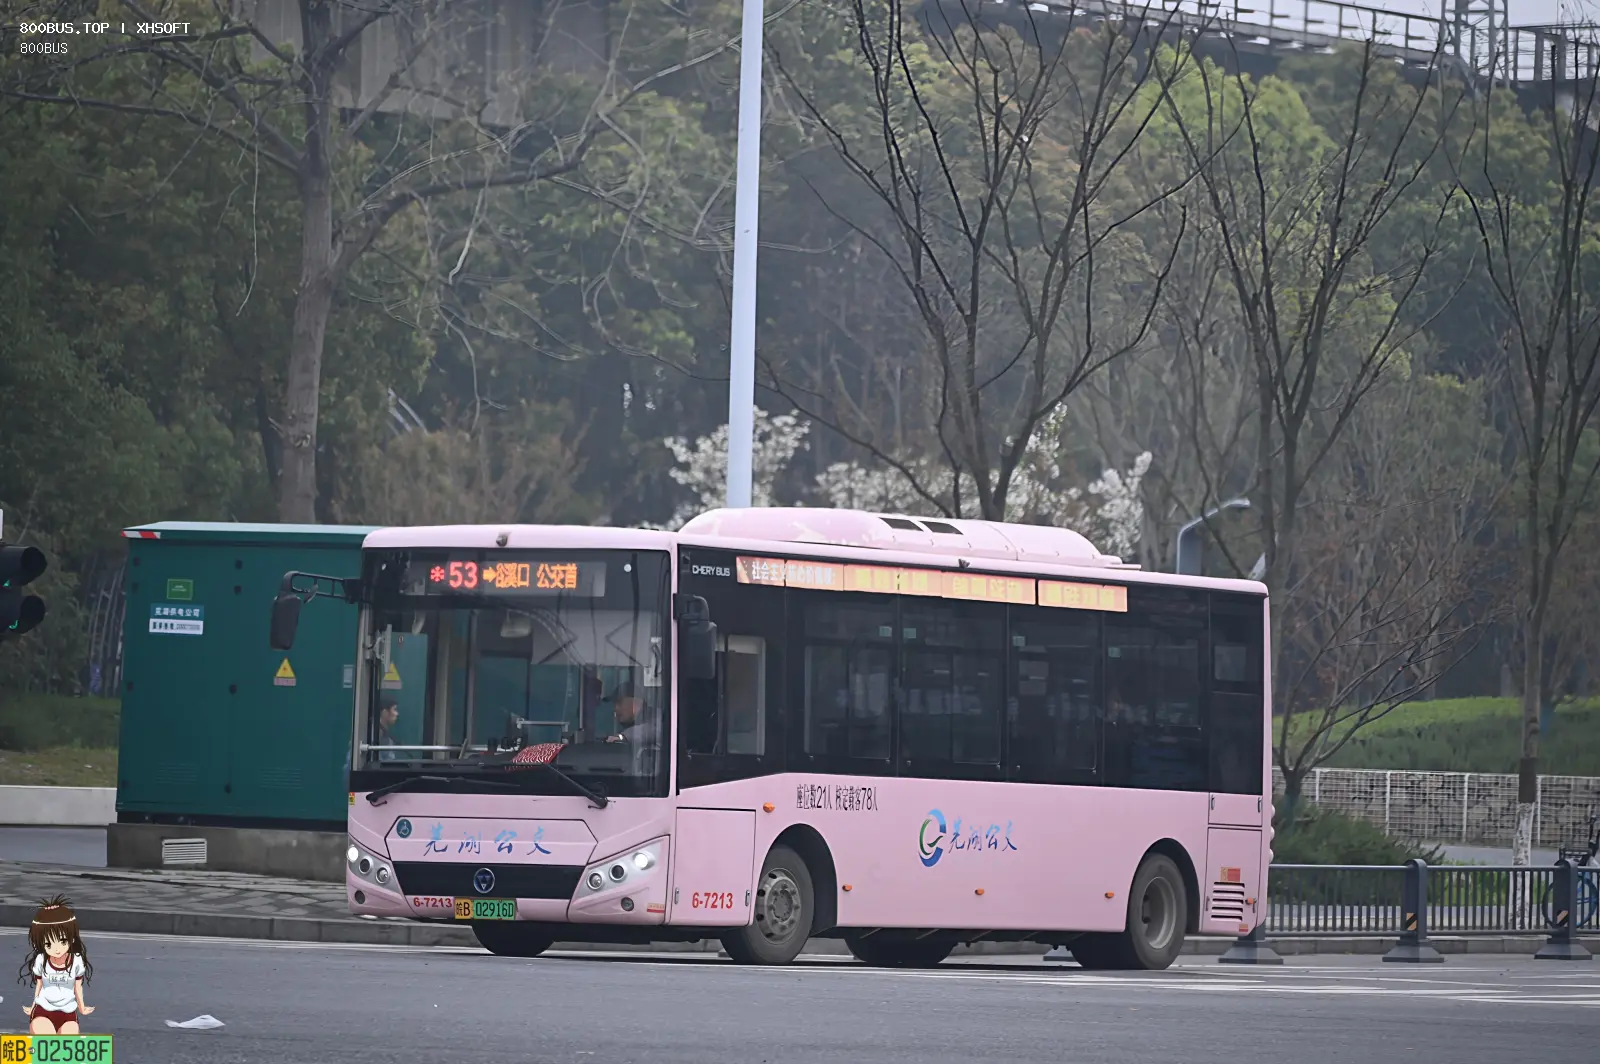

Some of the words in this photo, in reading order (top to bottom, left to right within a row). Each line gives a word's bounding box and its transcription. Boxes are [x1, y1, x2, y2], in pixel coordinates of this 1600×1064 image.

[449, 561, 479, 589] 53
[536, 562, 578, 589] 公交首
[716, 566, 731, 577] BUS
[412, 896, 453, 909] 6-7213
[691, 891, 734, 909] 6-7213
[475, 901, 515, 918] 02916D
